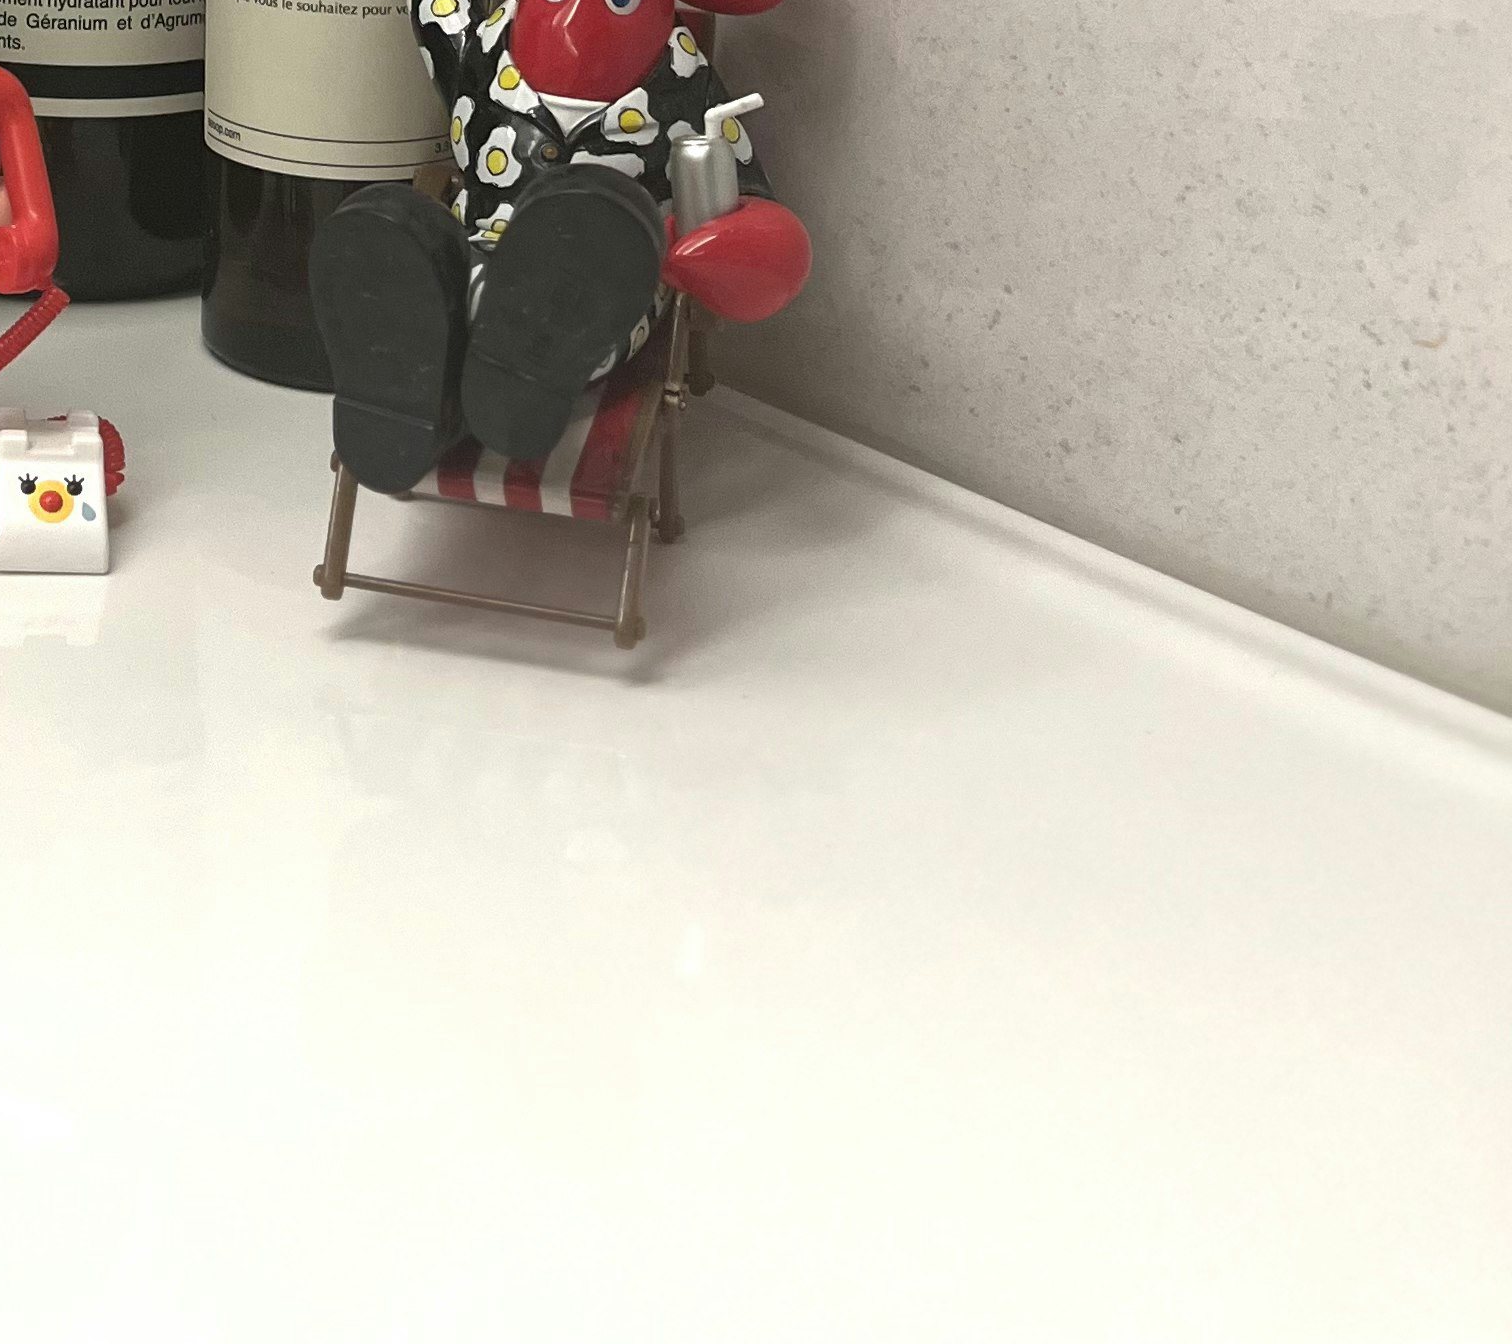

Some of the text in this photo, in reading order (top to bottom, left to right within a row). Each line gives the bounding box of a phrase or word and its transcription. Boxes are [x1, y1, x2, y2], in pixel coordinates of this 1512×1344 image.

[296, 0, 358, 16] souhaitez
[362, 5, 392, 19] pour
[25, 12, 108, 31] Géranium
[116, 14, 133, 30] et
[140, 11, 205, 33] d'Agrum
